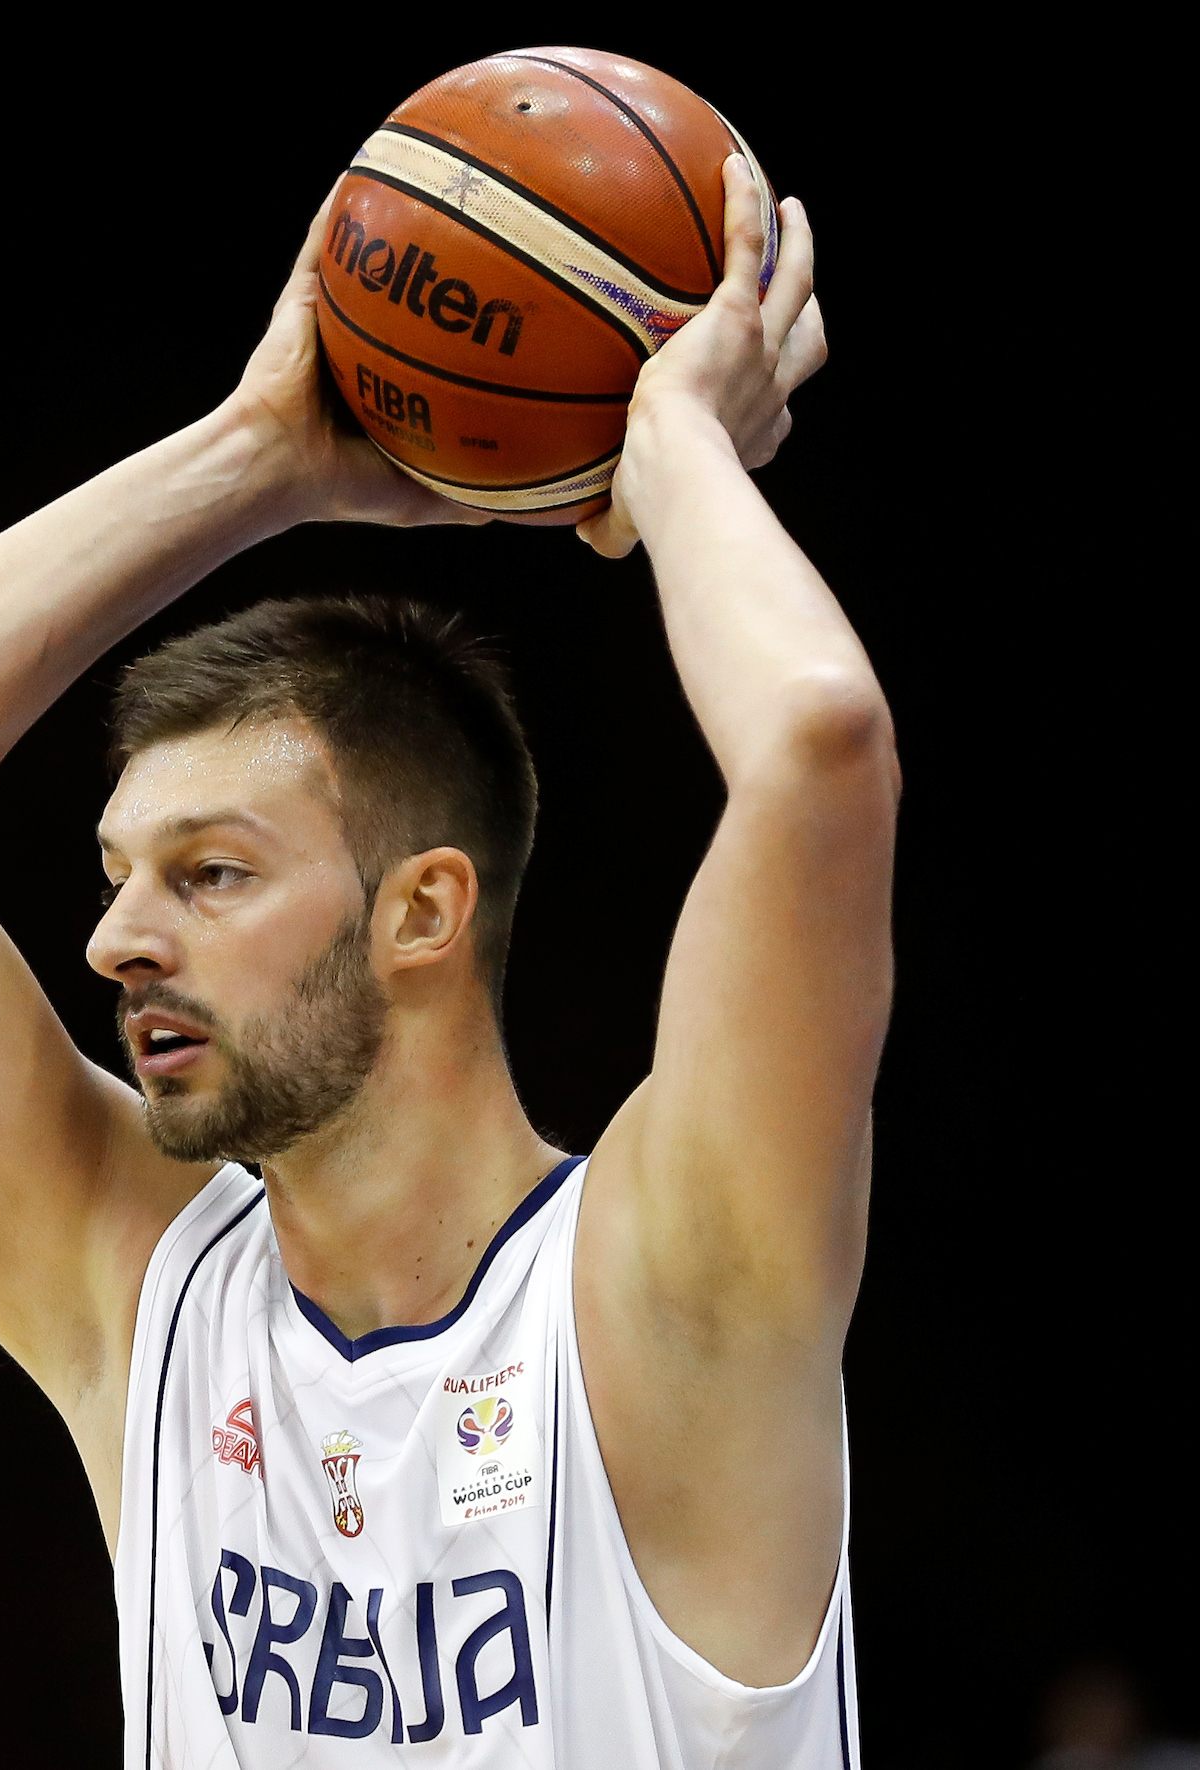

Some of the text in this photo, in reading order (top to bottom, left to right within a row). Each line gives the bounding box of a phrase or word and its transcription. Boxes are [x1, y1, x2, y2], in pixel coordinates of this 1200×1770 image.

[328, 210, 524, 357] molten
[357, 363, 432, 434] FIBA
[443, 1361, 525, 1395] QUALIFIERS
[452, 1468, 529, 1494] BASKETBALL
[481, 1464, 499, 1477] FIBA
[453, 1475, 532, 1505] WORLD CUP
[464, 1493, 525, 1518] China 2019
